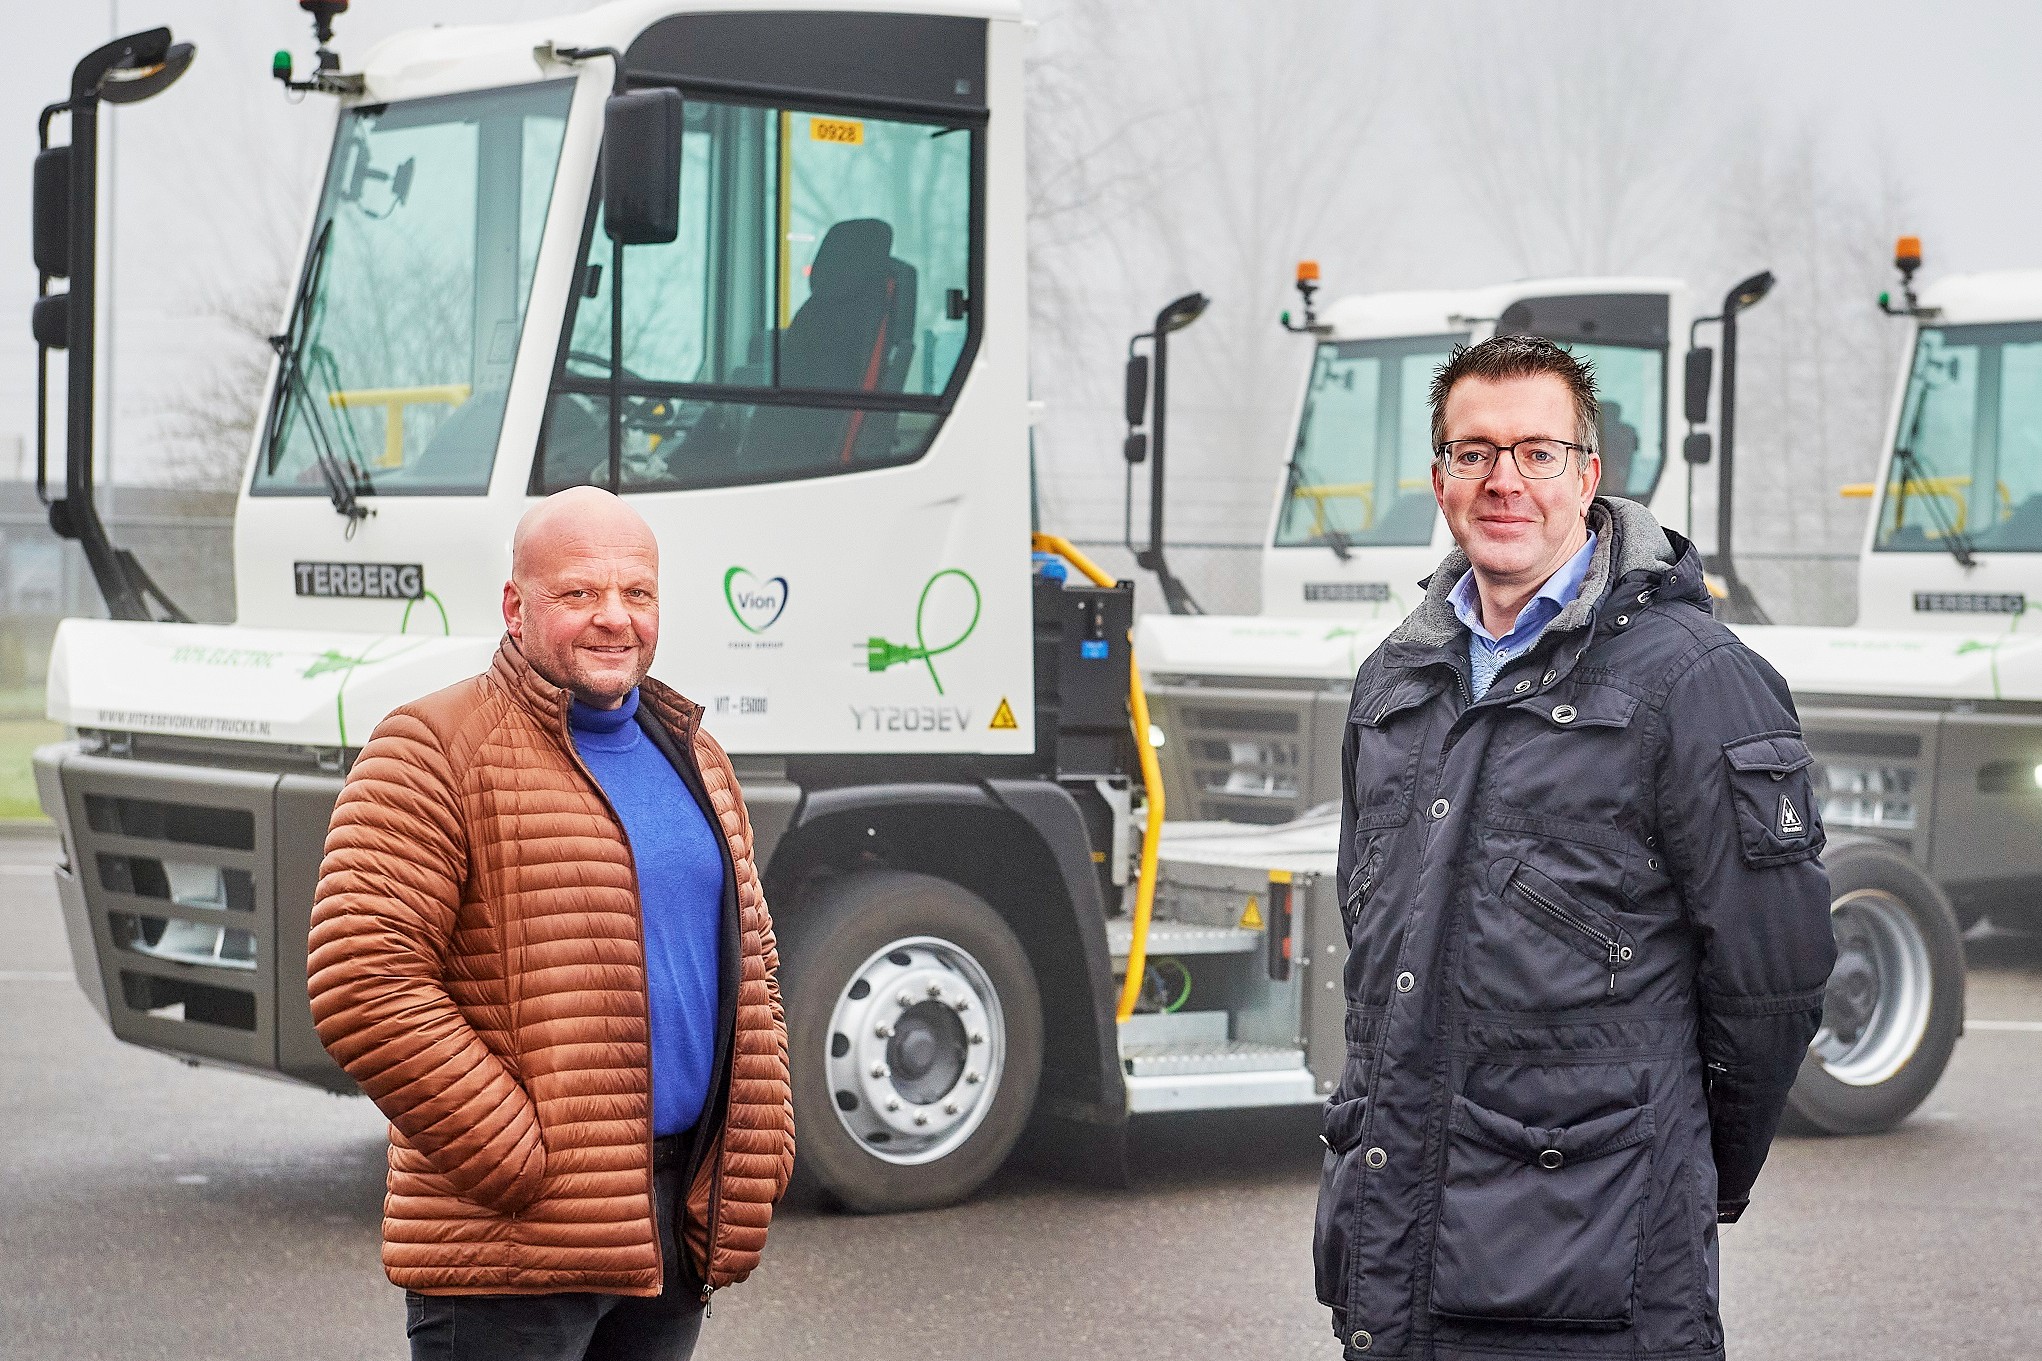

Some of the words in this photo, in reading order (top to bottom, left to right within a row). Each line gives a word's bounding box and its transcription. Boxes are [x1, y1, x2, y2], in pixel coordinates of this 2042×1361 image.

[817, 124, 857, 142] 0928
[296, 563, 421, 598] TERBERG
[738, 591, 776, 610] Vion
[850, 704, 972, 732] YT203EV
